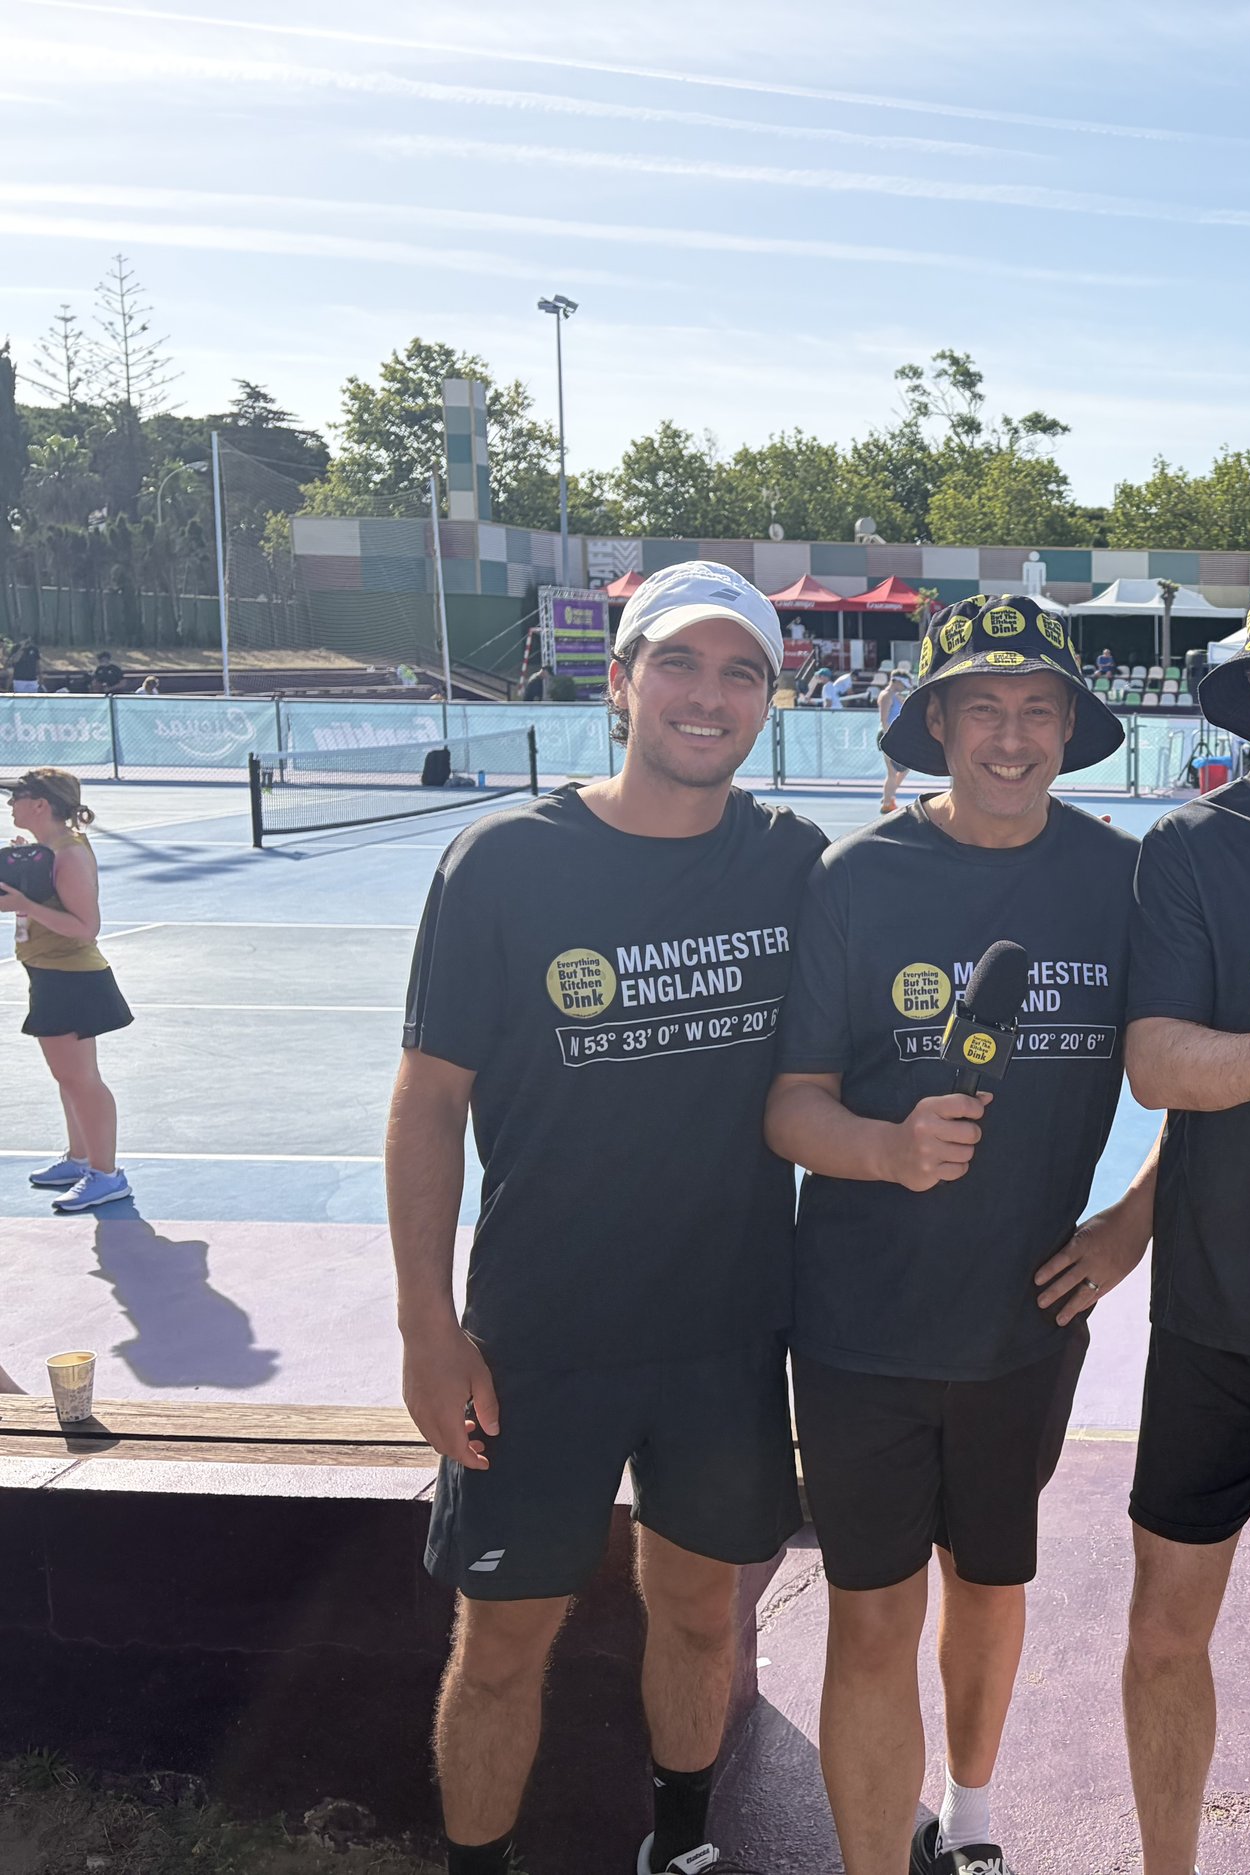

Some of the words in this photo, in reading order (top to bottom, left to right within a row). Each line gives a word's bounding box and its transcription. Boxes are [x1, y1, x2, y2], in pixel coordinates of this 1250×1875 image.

[991, 624, 1018, 634] Dink
[947, 634, 965, 651] Dink
[616, 926, 790, 975] MANCHESTER
[557, 957, 600, 969] Everything
[558, 969, 577, 980] But
[580, 966, 601, 977] The
[903, 970, 938, 979] Everything
[954, 961, 1108, 986] MHESTER
[560, 978, 602, 991] Kitchen
[621, 966, 742, 1007] ENGLAND
[904, 979, 919, 987] But
[922, 978, 939, 986] The
[904, 986, 939, 996] Kitchen
[562, 989, 604, 1009] Dink
[904, 995, 939, 1011] Dink
[570, 1036, 579, 1057] N
[685, 1021, 703, 1041] W
[907, 1037, 917, 1053] N
[967, 1049, 987, 1061] Dink
